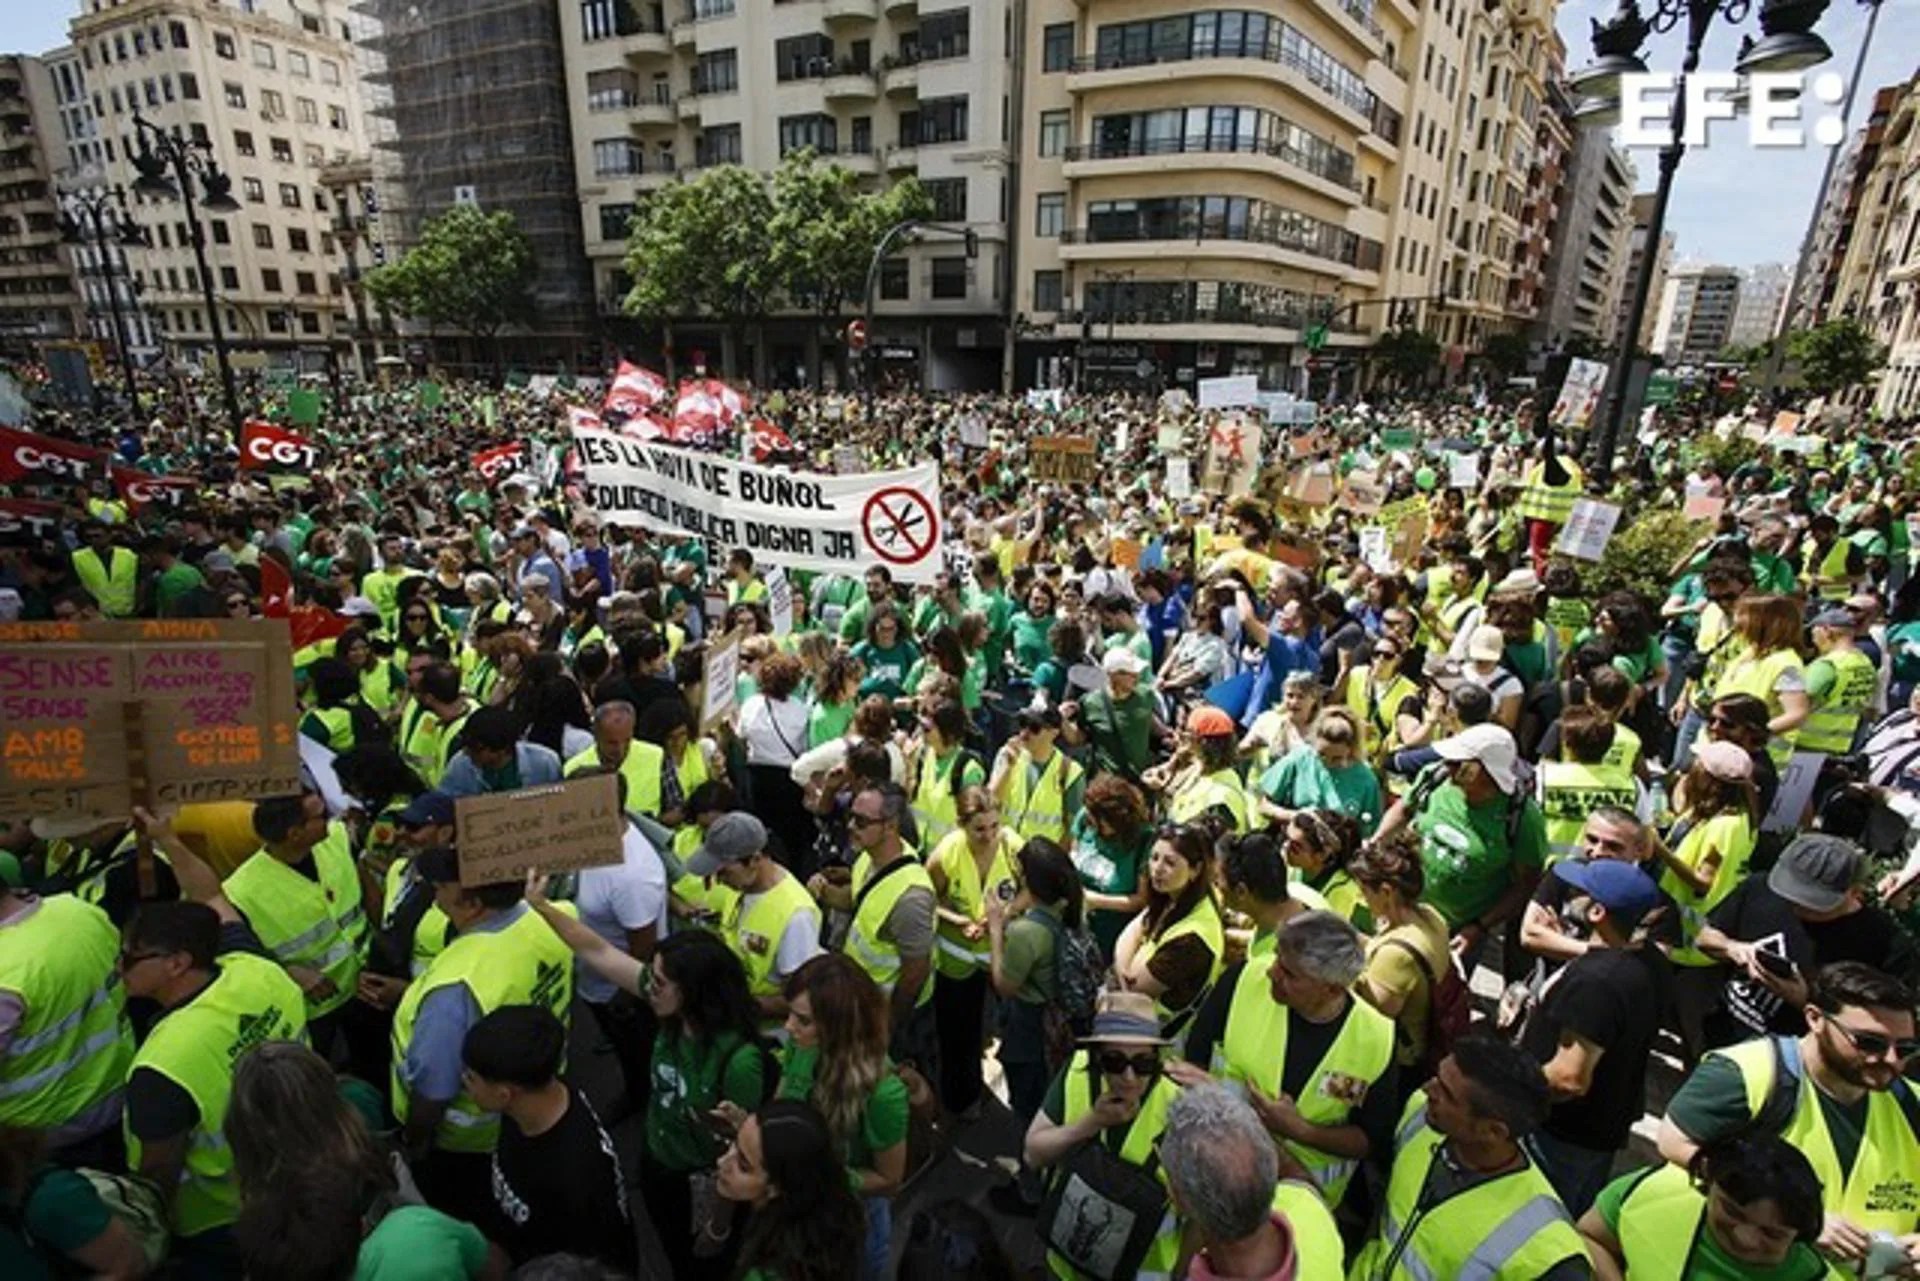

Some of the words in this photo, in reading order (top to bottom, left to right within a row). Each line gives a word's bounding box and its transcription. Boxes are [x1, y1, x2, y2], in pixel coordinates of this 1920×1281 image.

[14, 446, 91, 480] CGT
[249, 436, 320, 469] CGT
[575, 437, 619, 465] IES
[618, 441, 651, 472] LA
[700, 461, 731, 497] DE
[739, 470, 837, 511] BUÑOL
[128, 482, 183, 507] CGT
[745, 520, 814, 555] DIGNA
[821, 529, 857, 560] JA
[0, 656, 113, 690] SENSE
[3, 697, 89, 721] SENSE
[4, 727, 86, 757] AMB
[9, 757, 87, 780] TALLS
